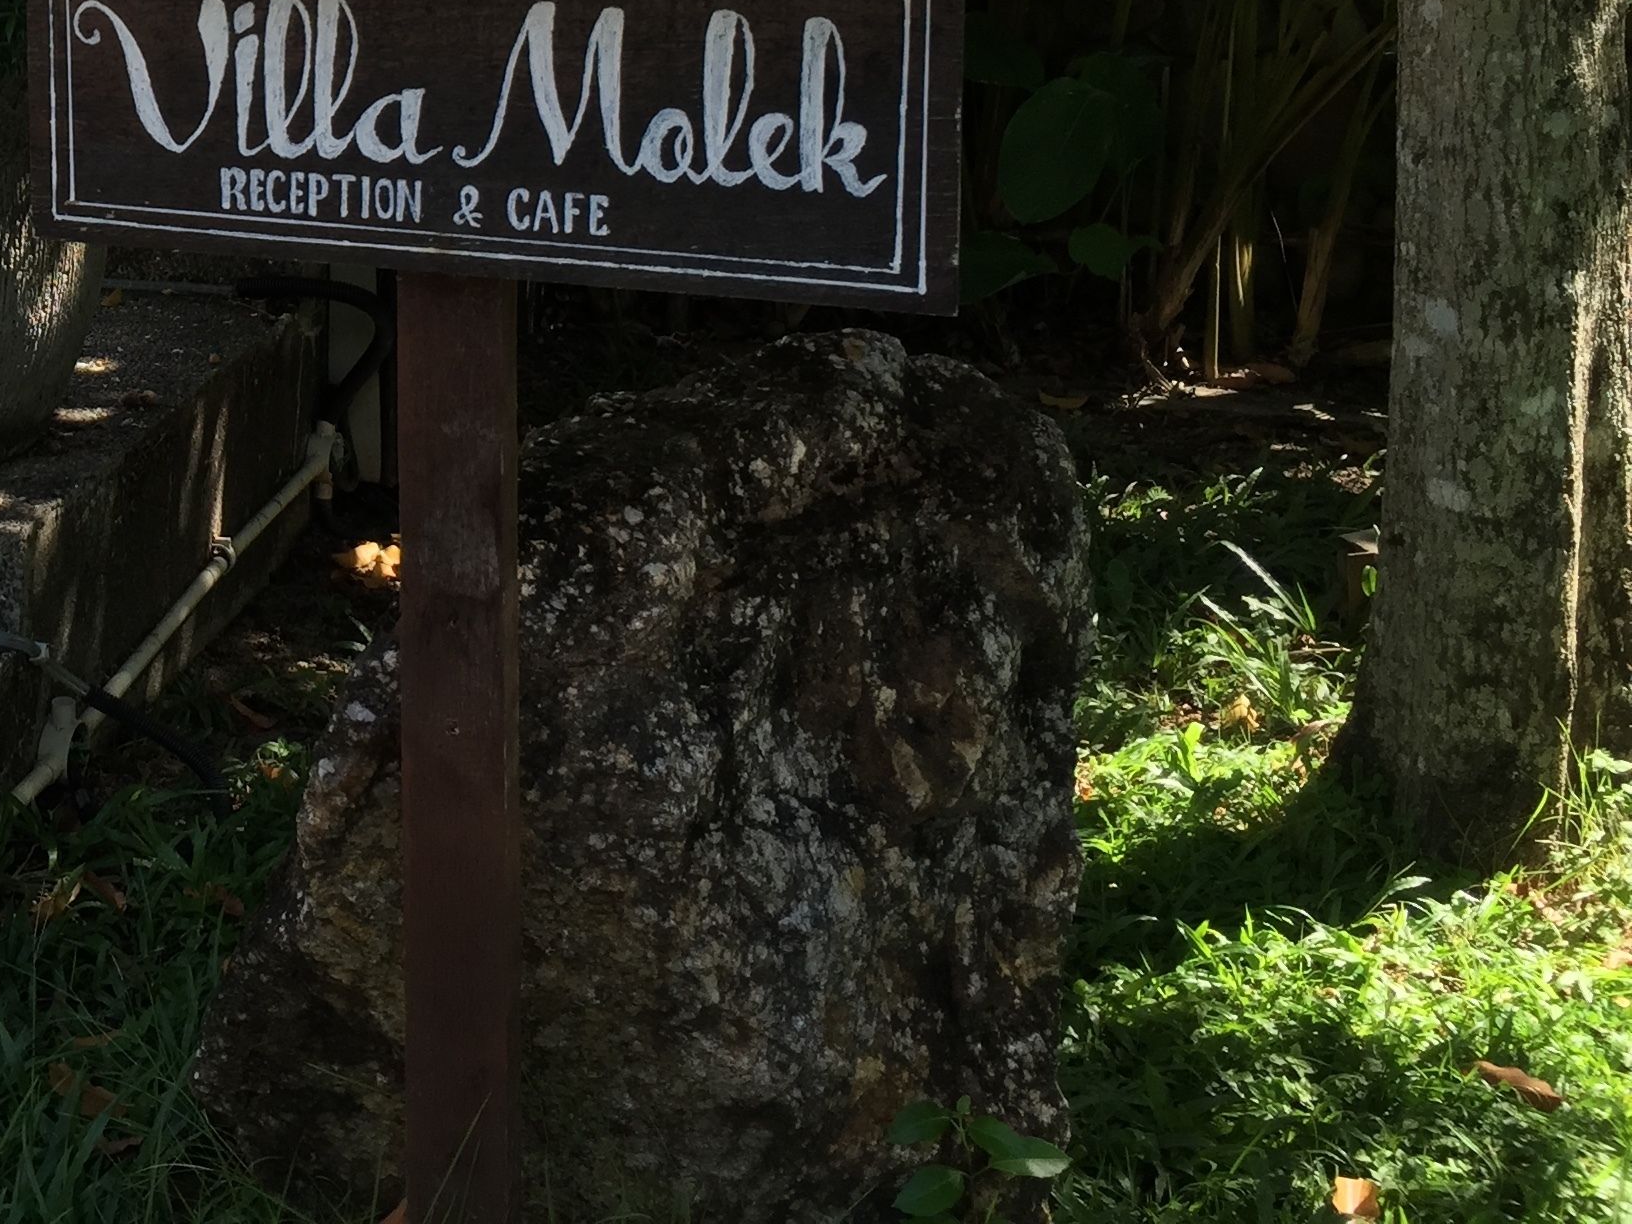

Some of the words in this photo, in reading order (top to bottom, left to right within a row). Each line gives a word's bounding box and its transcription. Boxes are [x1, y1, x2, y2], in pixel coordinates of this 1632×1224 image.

[220, 167, 423, 224] RECEPTION
[453, 185, 483, 228] &
[507, 188, 611, 236] CAFE
